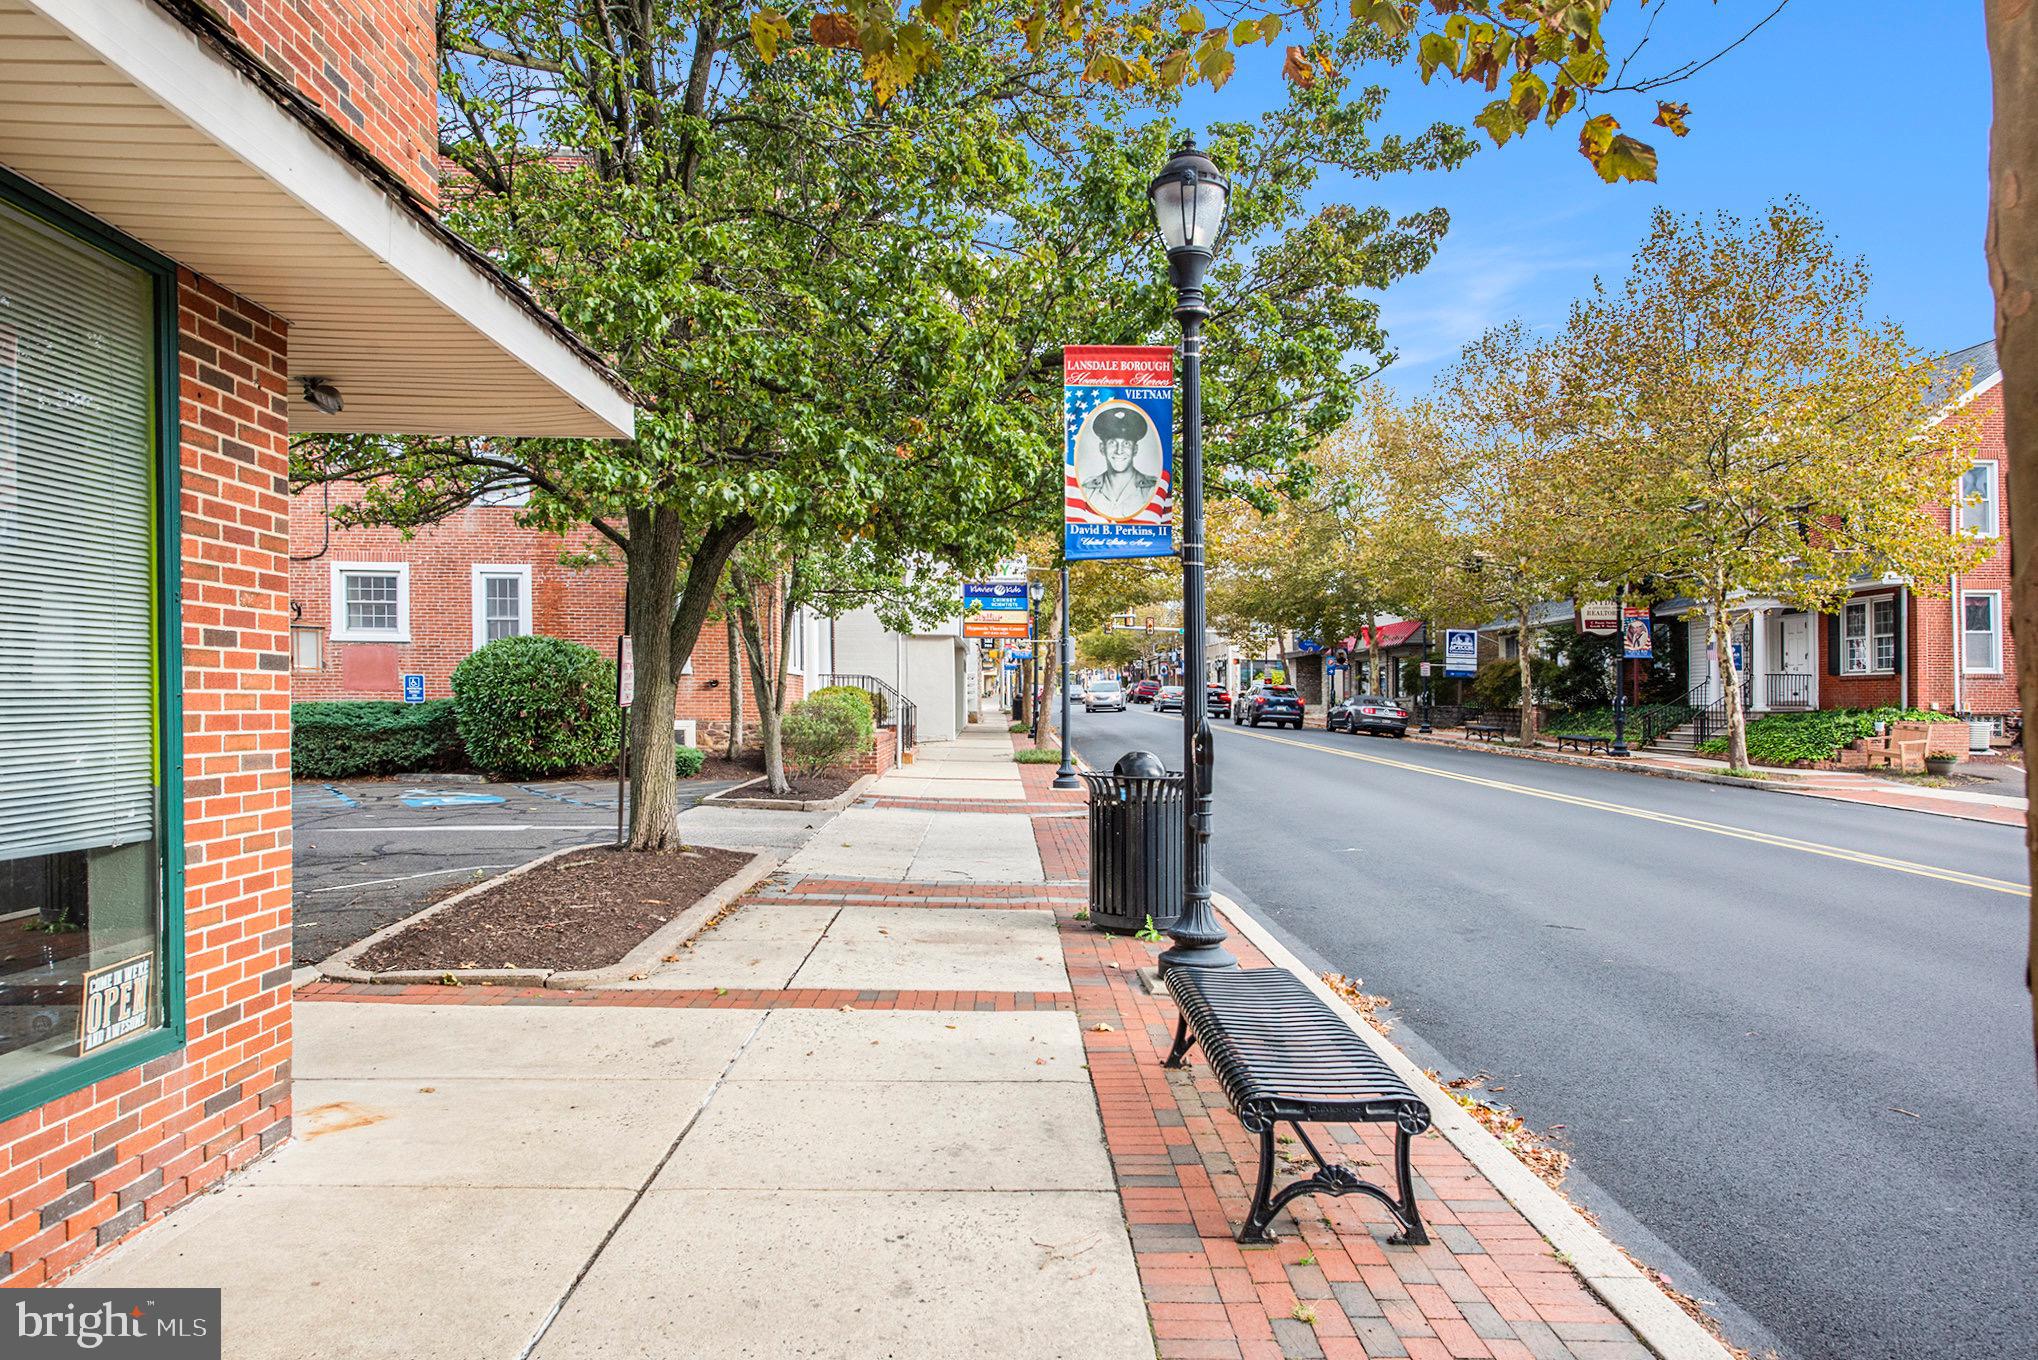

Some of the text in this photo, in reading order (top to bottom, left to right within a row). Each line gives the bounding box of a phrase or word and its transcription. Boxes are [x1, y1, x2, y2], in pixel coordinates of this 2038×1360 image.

[1067, 360, 1170, 371] LANSDALE BOROUGH
[1066, 372, 1170, 386] Hometown Heroes
[1125, 389, 1172, 400] VIETNAM
[1070, 524, 1167, 536] David B. Perkins, II
[1081, 537, 1104, 546] United
[1130, 538, 1153, 547] Army
[90, 973, 112, 994] COME
[114, 969, 122, 986] IN
[86, 975, 148, 1034] OPEN
[85, 1011, 146, 1050] AND AWESOME
